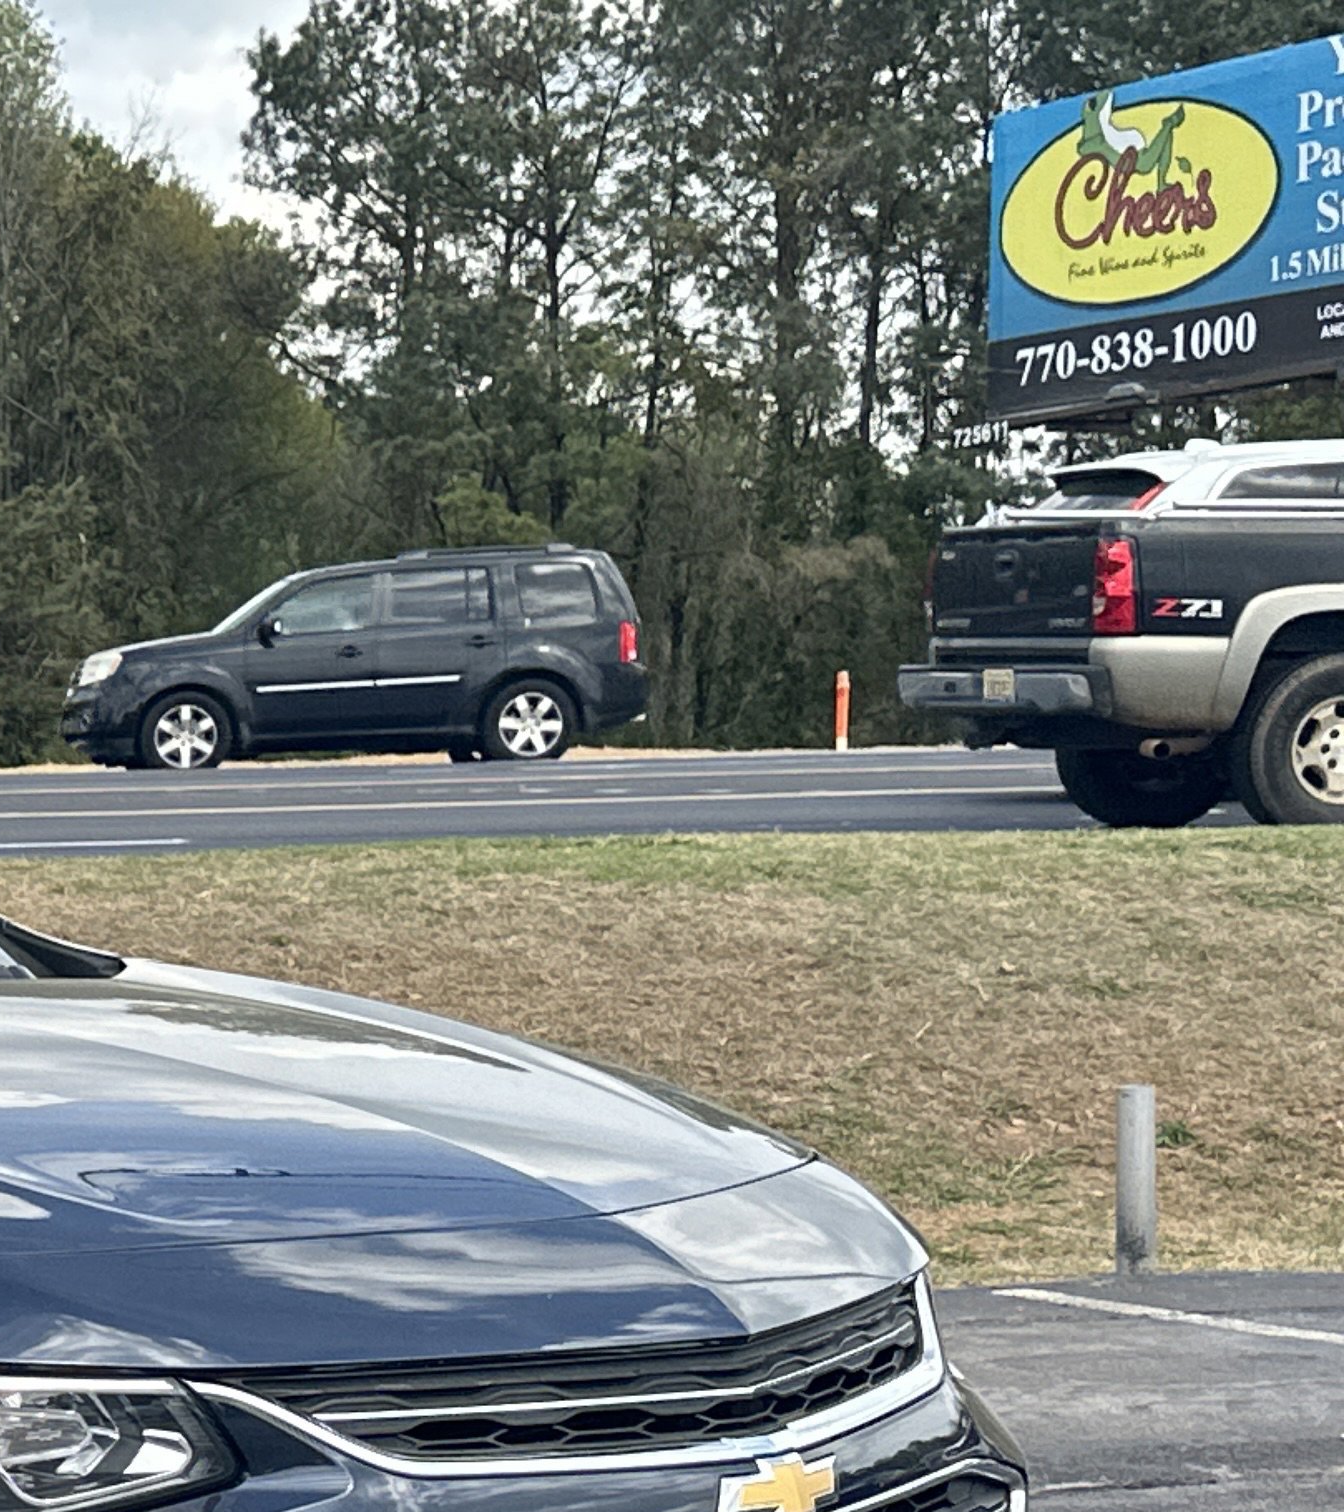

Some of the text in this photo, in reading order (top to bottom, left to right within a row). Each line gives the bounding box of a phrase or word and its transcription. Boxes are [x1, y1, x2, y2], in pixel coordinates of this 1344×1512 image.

[1296, 89, 1344, 134] Pr
[1296, 140, 1344, 183] Pa
[1054, 145, 1217, 250] Cheers
[1270, 250, 1302, 282] 1.5
[1316, 302, 1344, 321] LOC
[1014, 310, 1257, 387] 770-838-1000
[953, 420, 1009, 449] 725611
[1152, 598, 1223, 619] Z71
